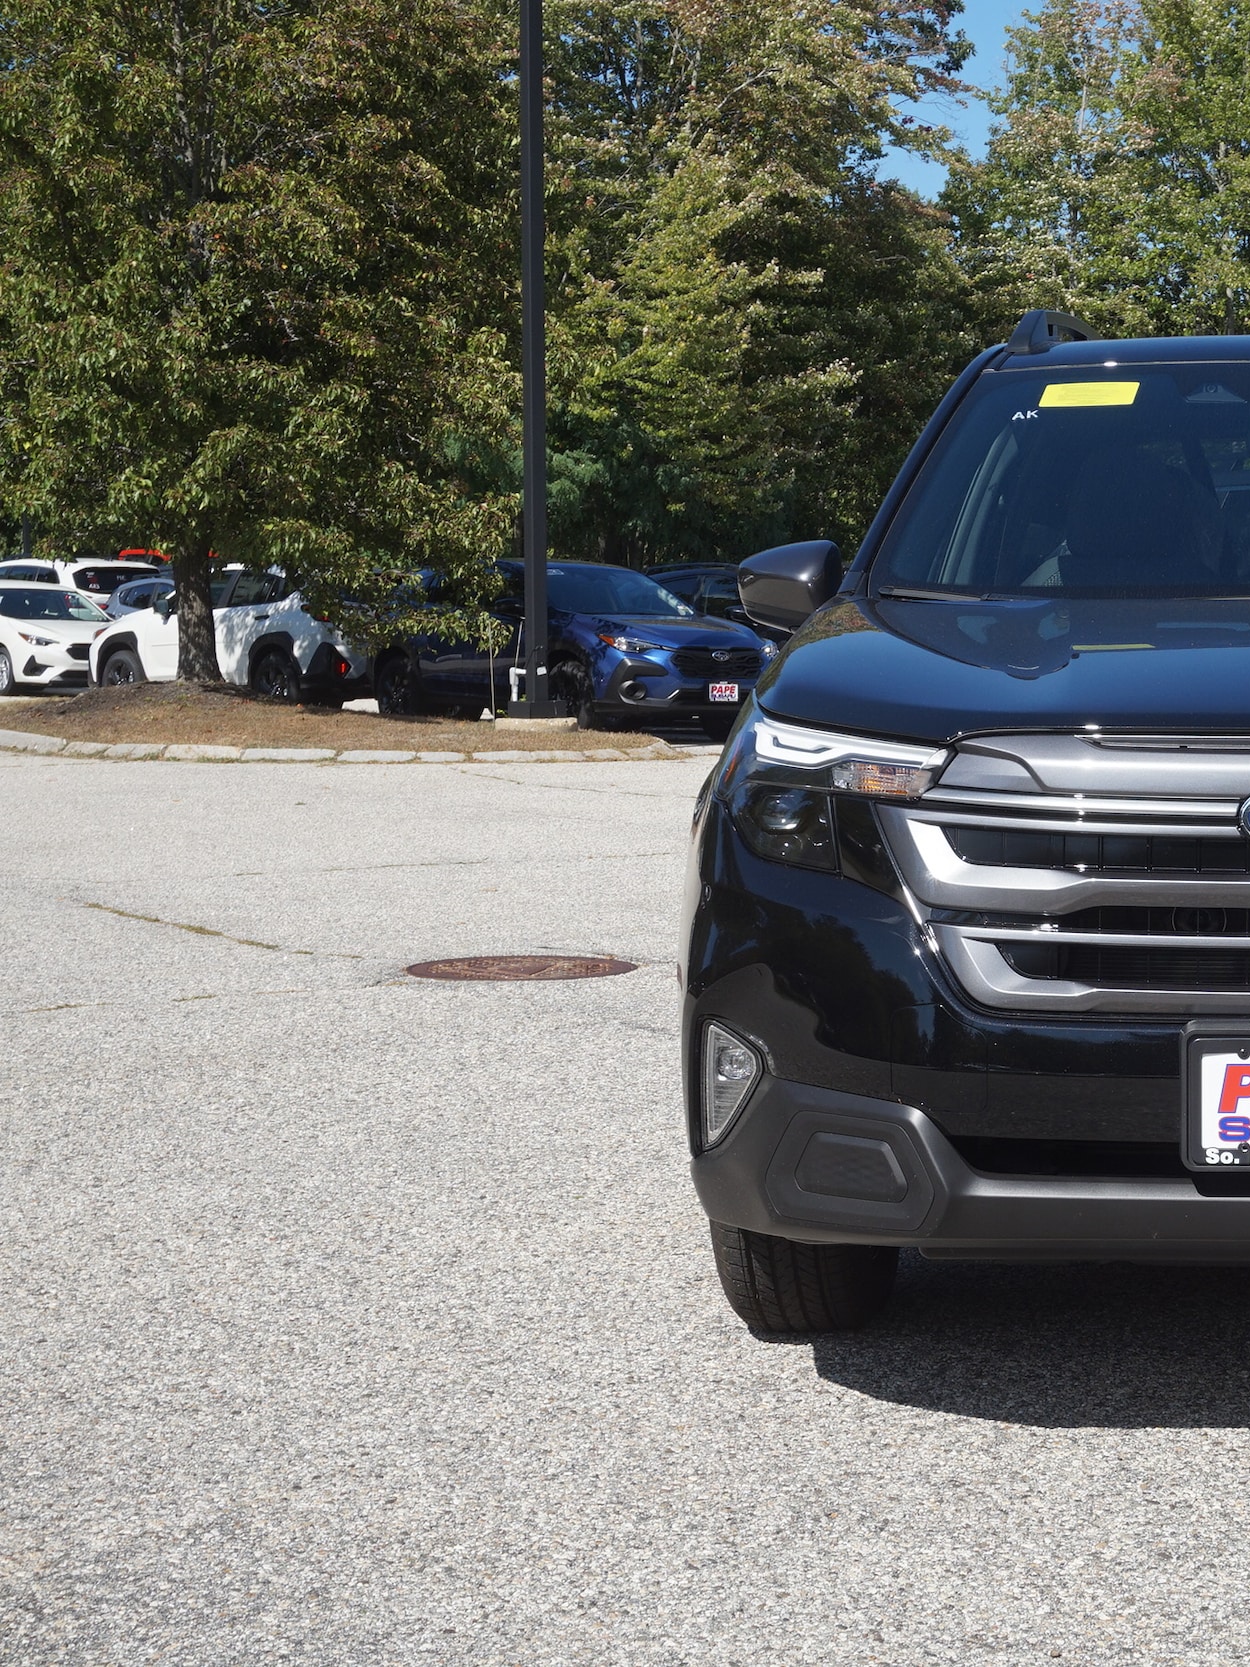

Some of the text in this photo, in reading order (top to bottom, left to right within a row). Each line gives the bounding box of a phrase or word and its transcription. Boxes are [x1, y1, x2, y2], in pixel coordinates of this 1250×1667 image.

[1011, 409, 1039, 421] AK
[711, 685, 736, 694] PAPE
[1205, 1148, 1240, 1165] So.
